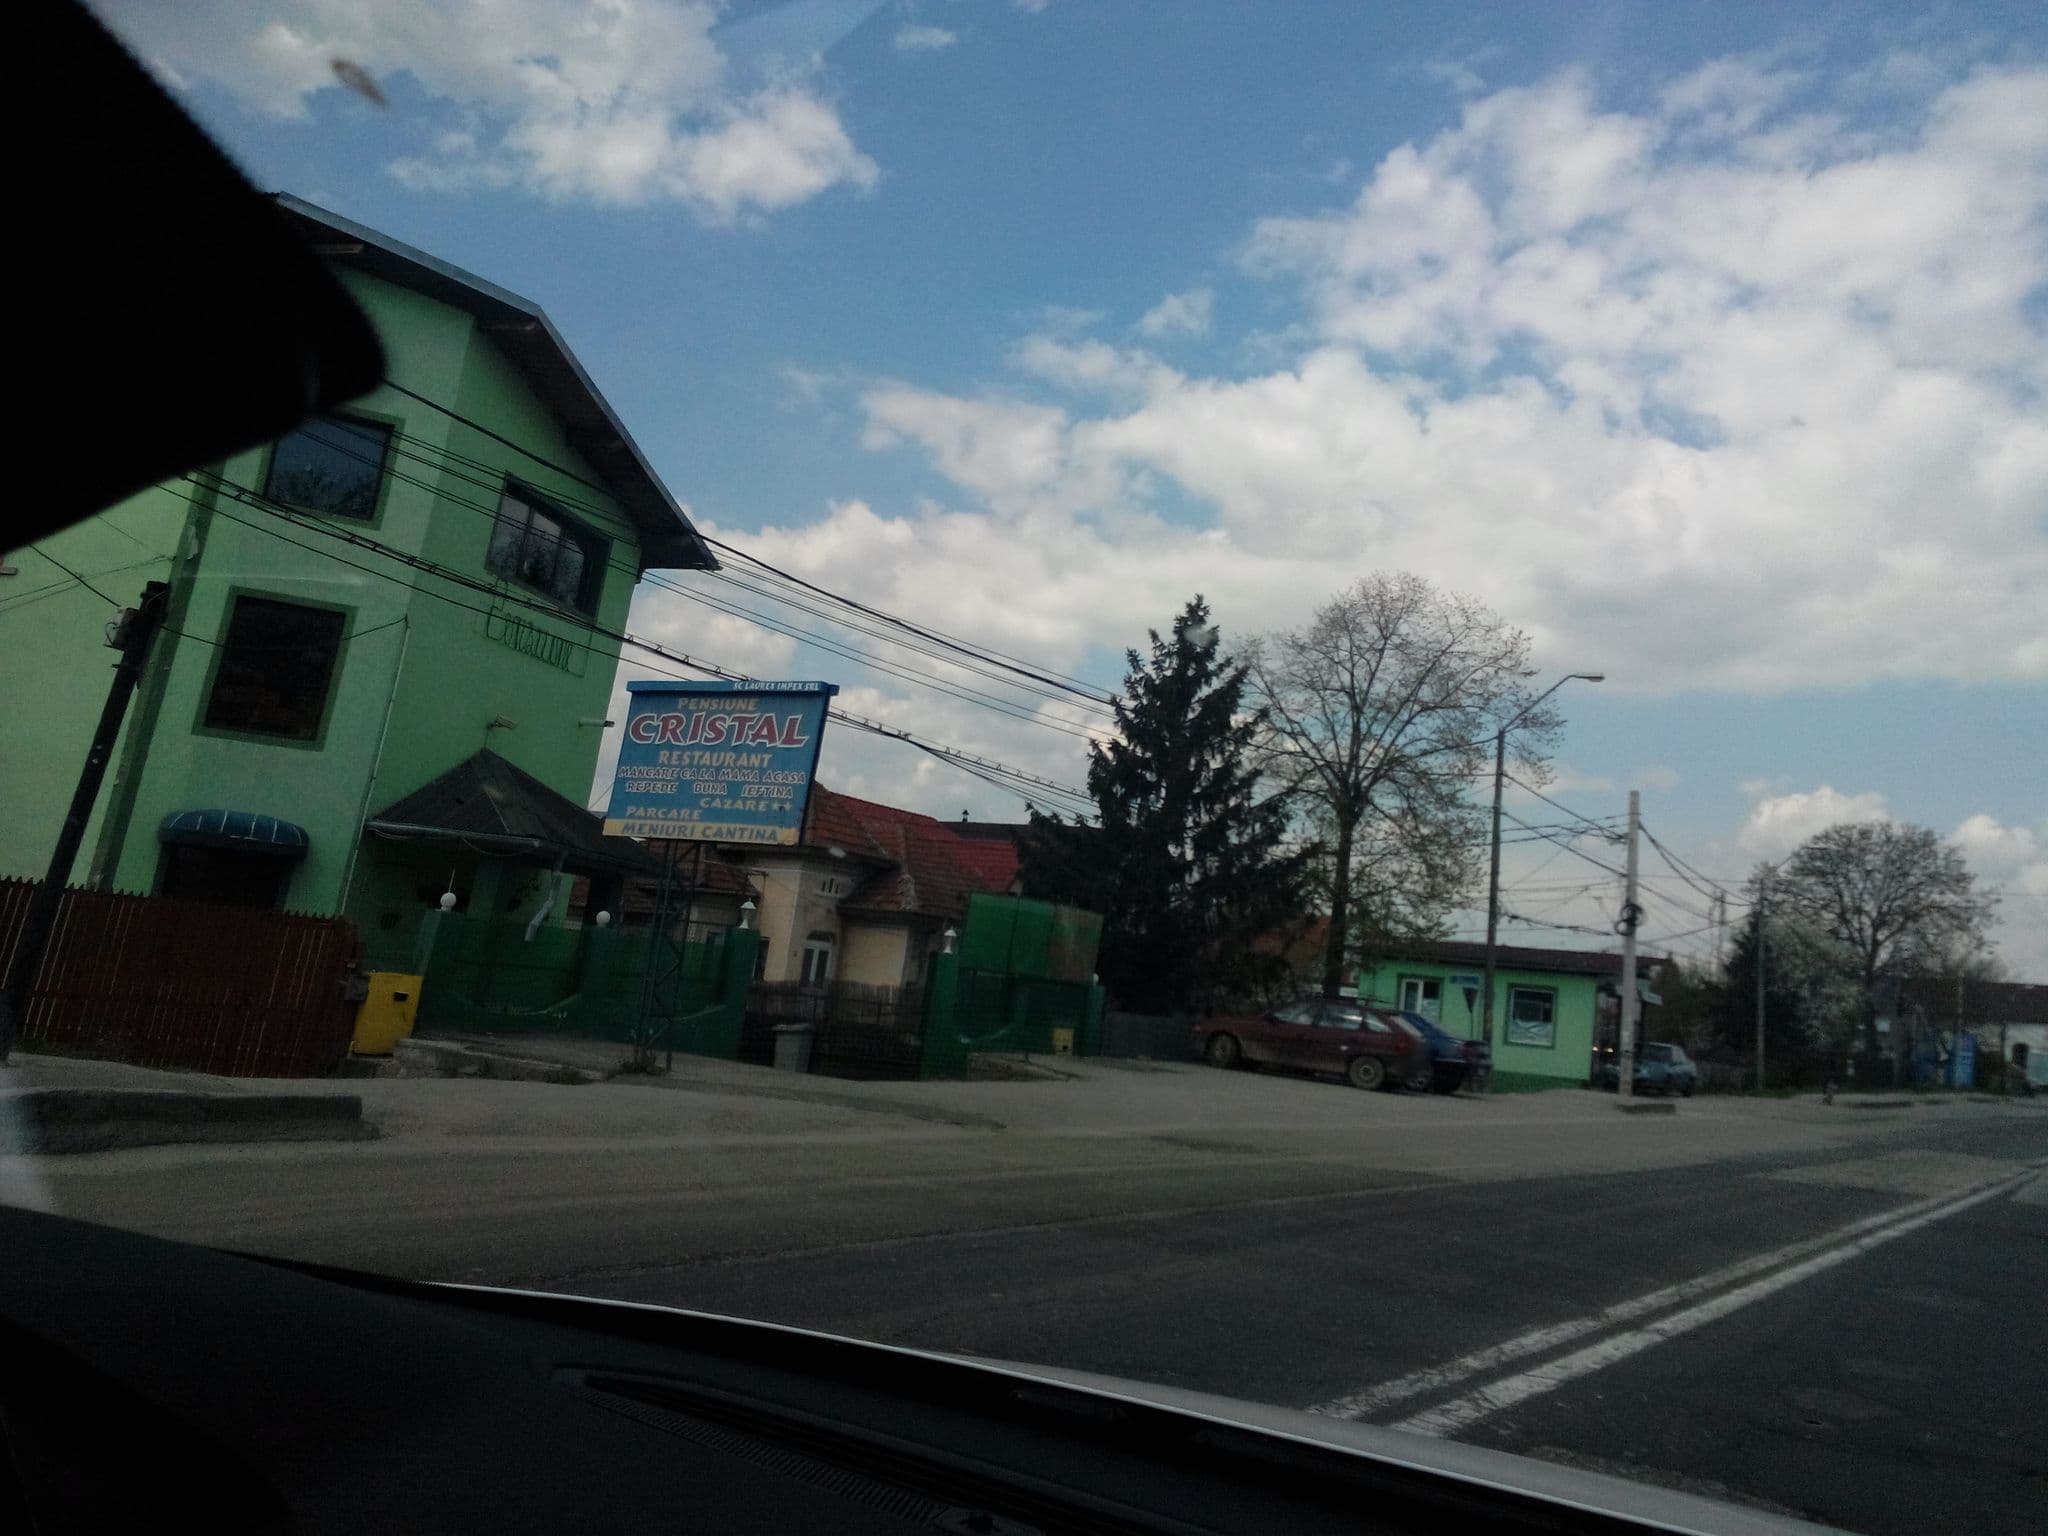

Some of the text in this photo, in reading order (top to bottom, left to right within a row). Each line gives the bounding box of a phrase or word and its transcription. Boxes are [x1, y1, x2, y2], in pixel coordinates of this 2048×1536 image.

[678, 697, 759, 710] PENSIUNE
[629, 712, 810, 748] CRISTAL
[658, 750, 772, 767] RESTAURANT
[618, 766, 806, 784] MANCARE CA LA MAMA ACASA
[626, 781, 679, 793] REPEDE
[693, 783, 728, 795] BUNA
[699, 797, 769, 812] CAZARE
[625, 806, 703, 821] PARCARE
[622, 822, 778, 842] MENIURI CANTINA
